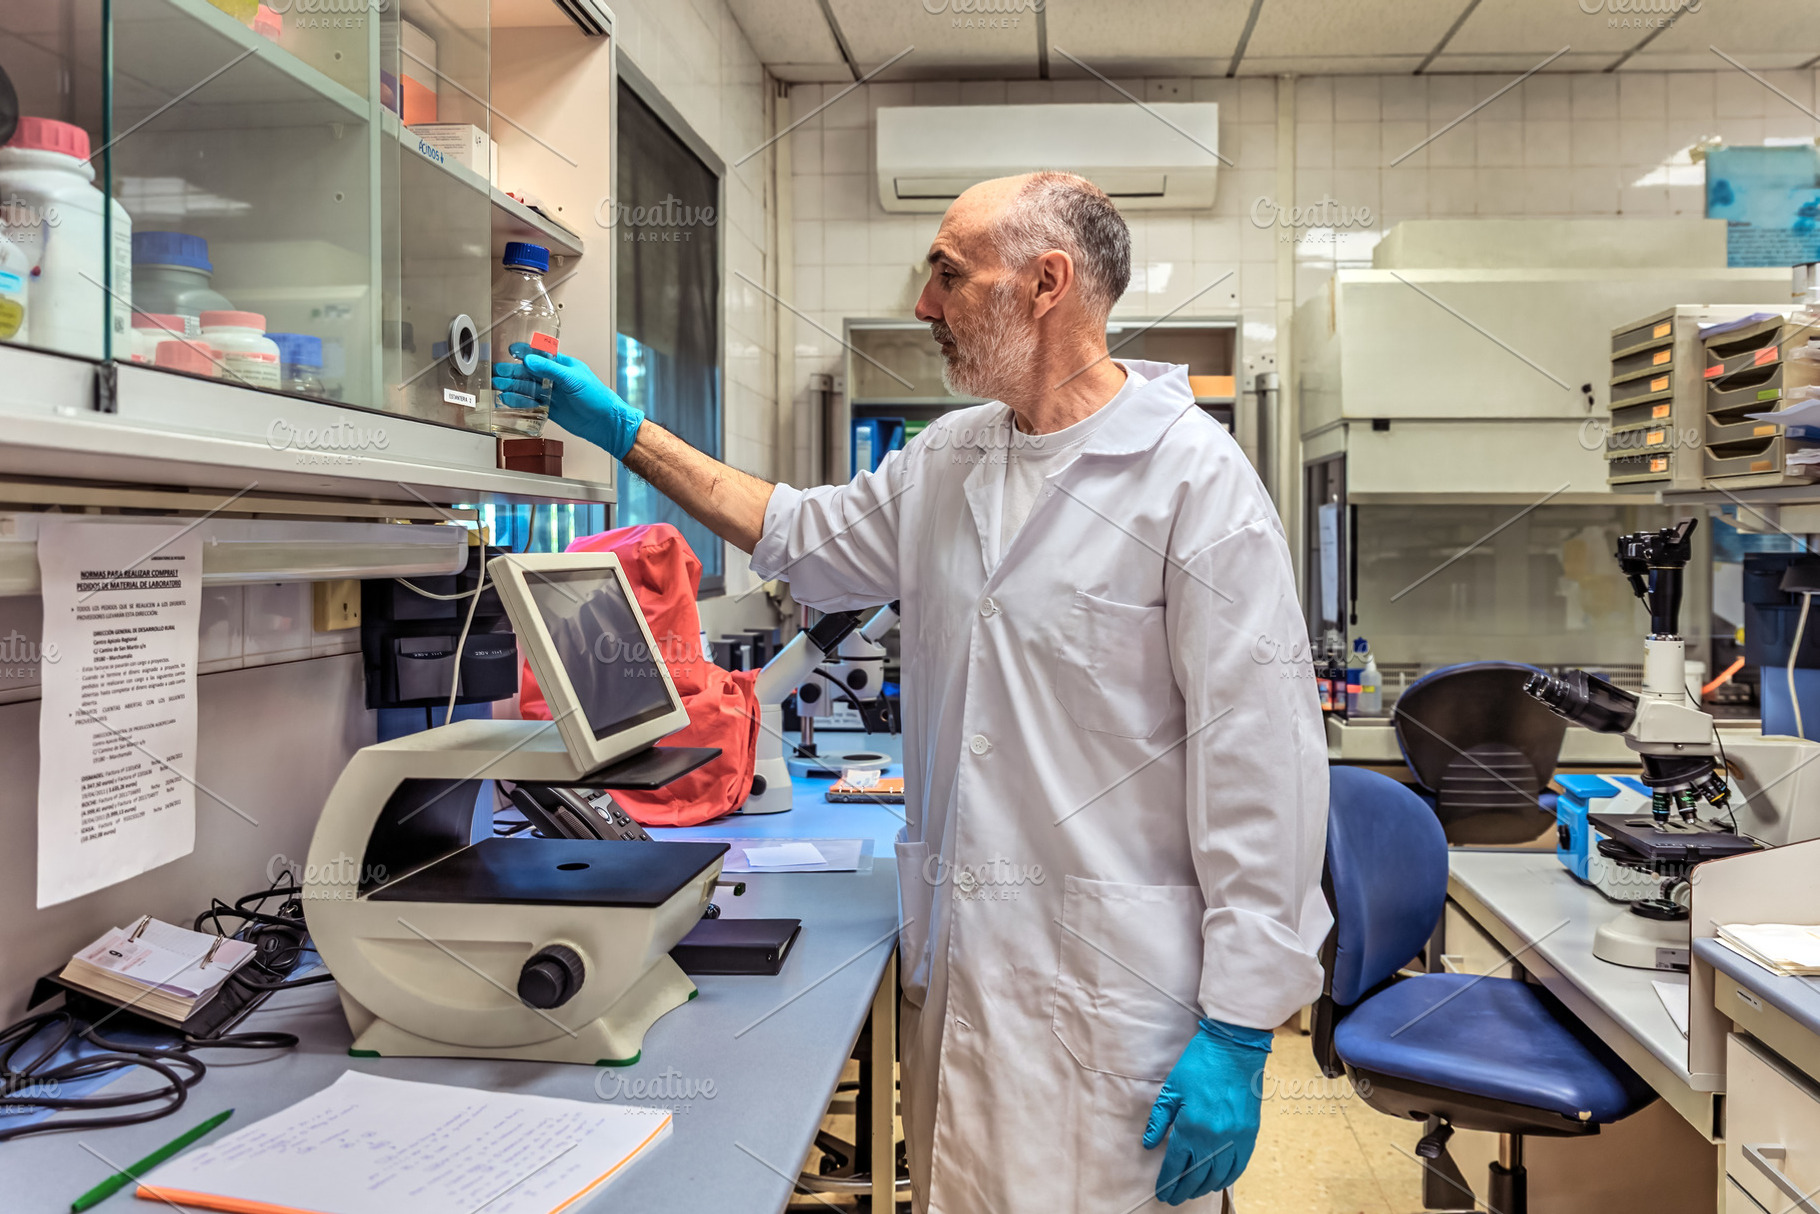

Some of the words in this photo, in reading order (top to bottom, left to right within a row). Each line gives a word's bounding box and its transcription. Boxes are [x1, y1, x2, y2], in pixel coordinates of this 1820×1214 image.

[418, 138, 440, 161] ÁCIDOS
[77, 583, 100, 591] PEDIDOS
[110, 581, 138, 589] MATERIAL
